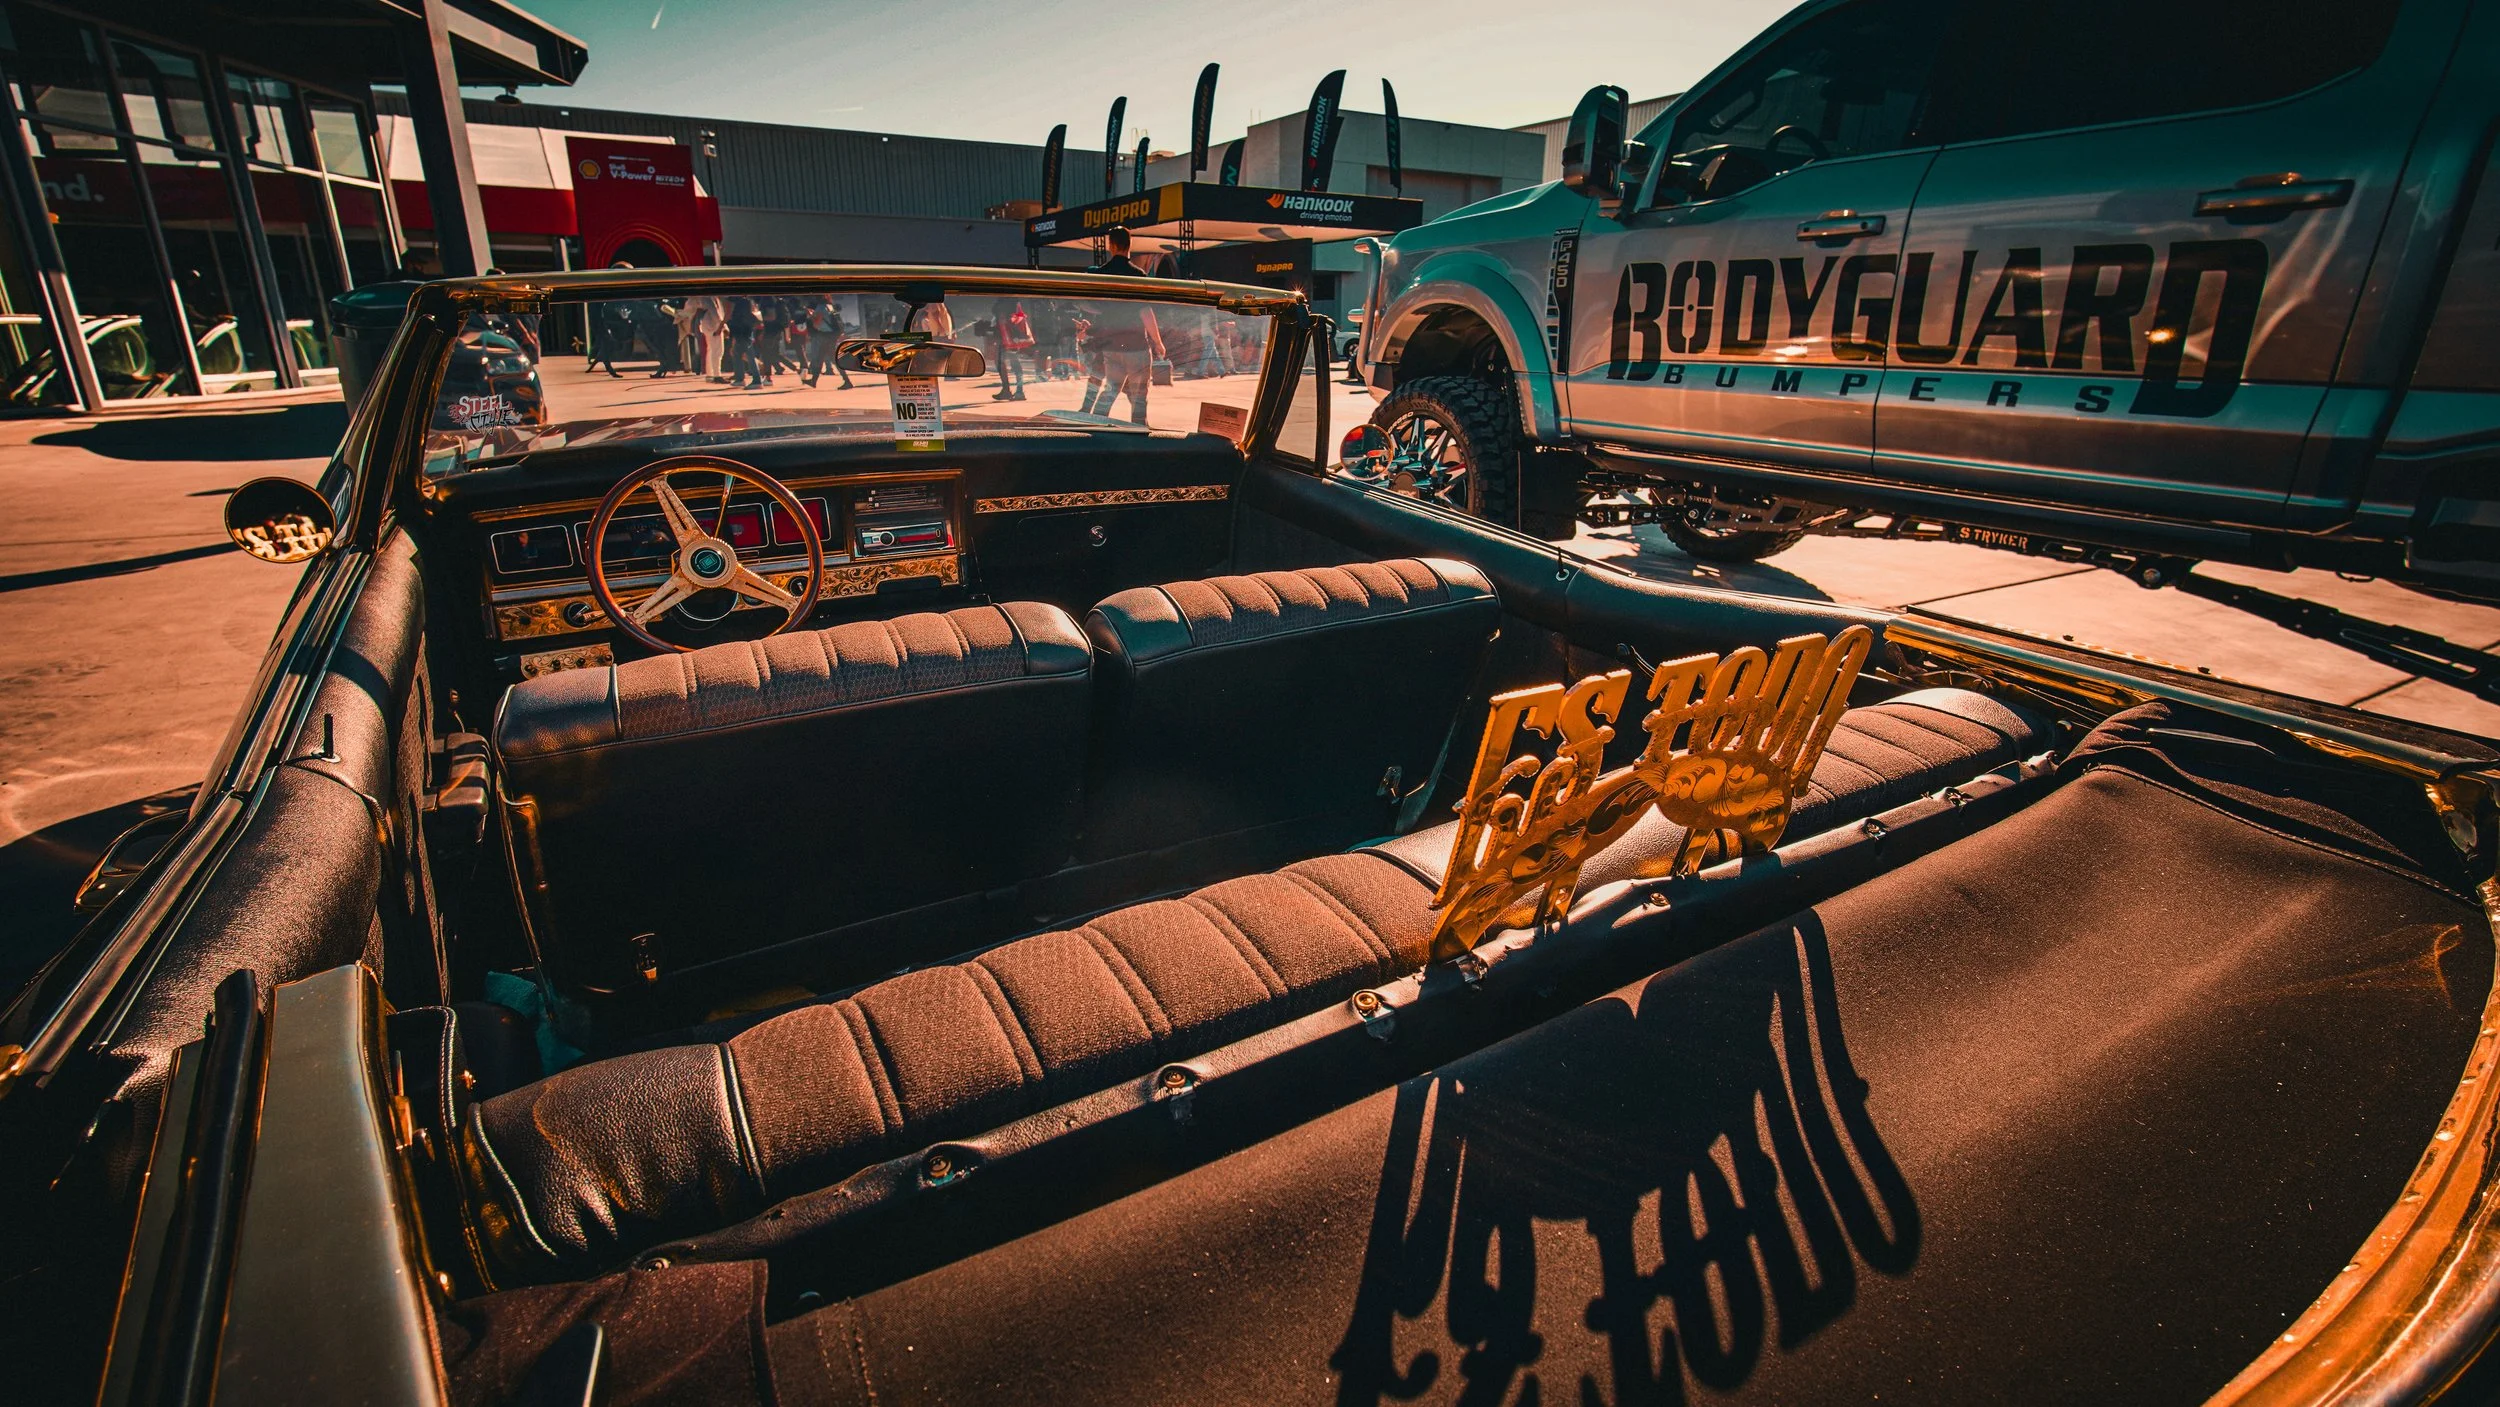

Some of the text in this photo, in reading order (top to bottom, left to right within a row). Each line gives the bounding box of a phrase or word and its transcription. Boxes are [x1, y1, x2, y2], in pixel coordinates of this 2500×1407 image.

[1606, 239, 2270, 418] BODYGUARD
[1663, 363, 2115, 413] BUMPERS
[458, 393, 511, 415] STEEL
[896, 402, 917, 420] NO
[1960, 526, 2028, 549] STRYKER
